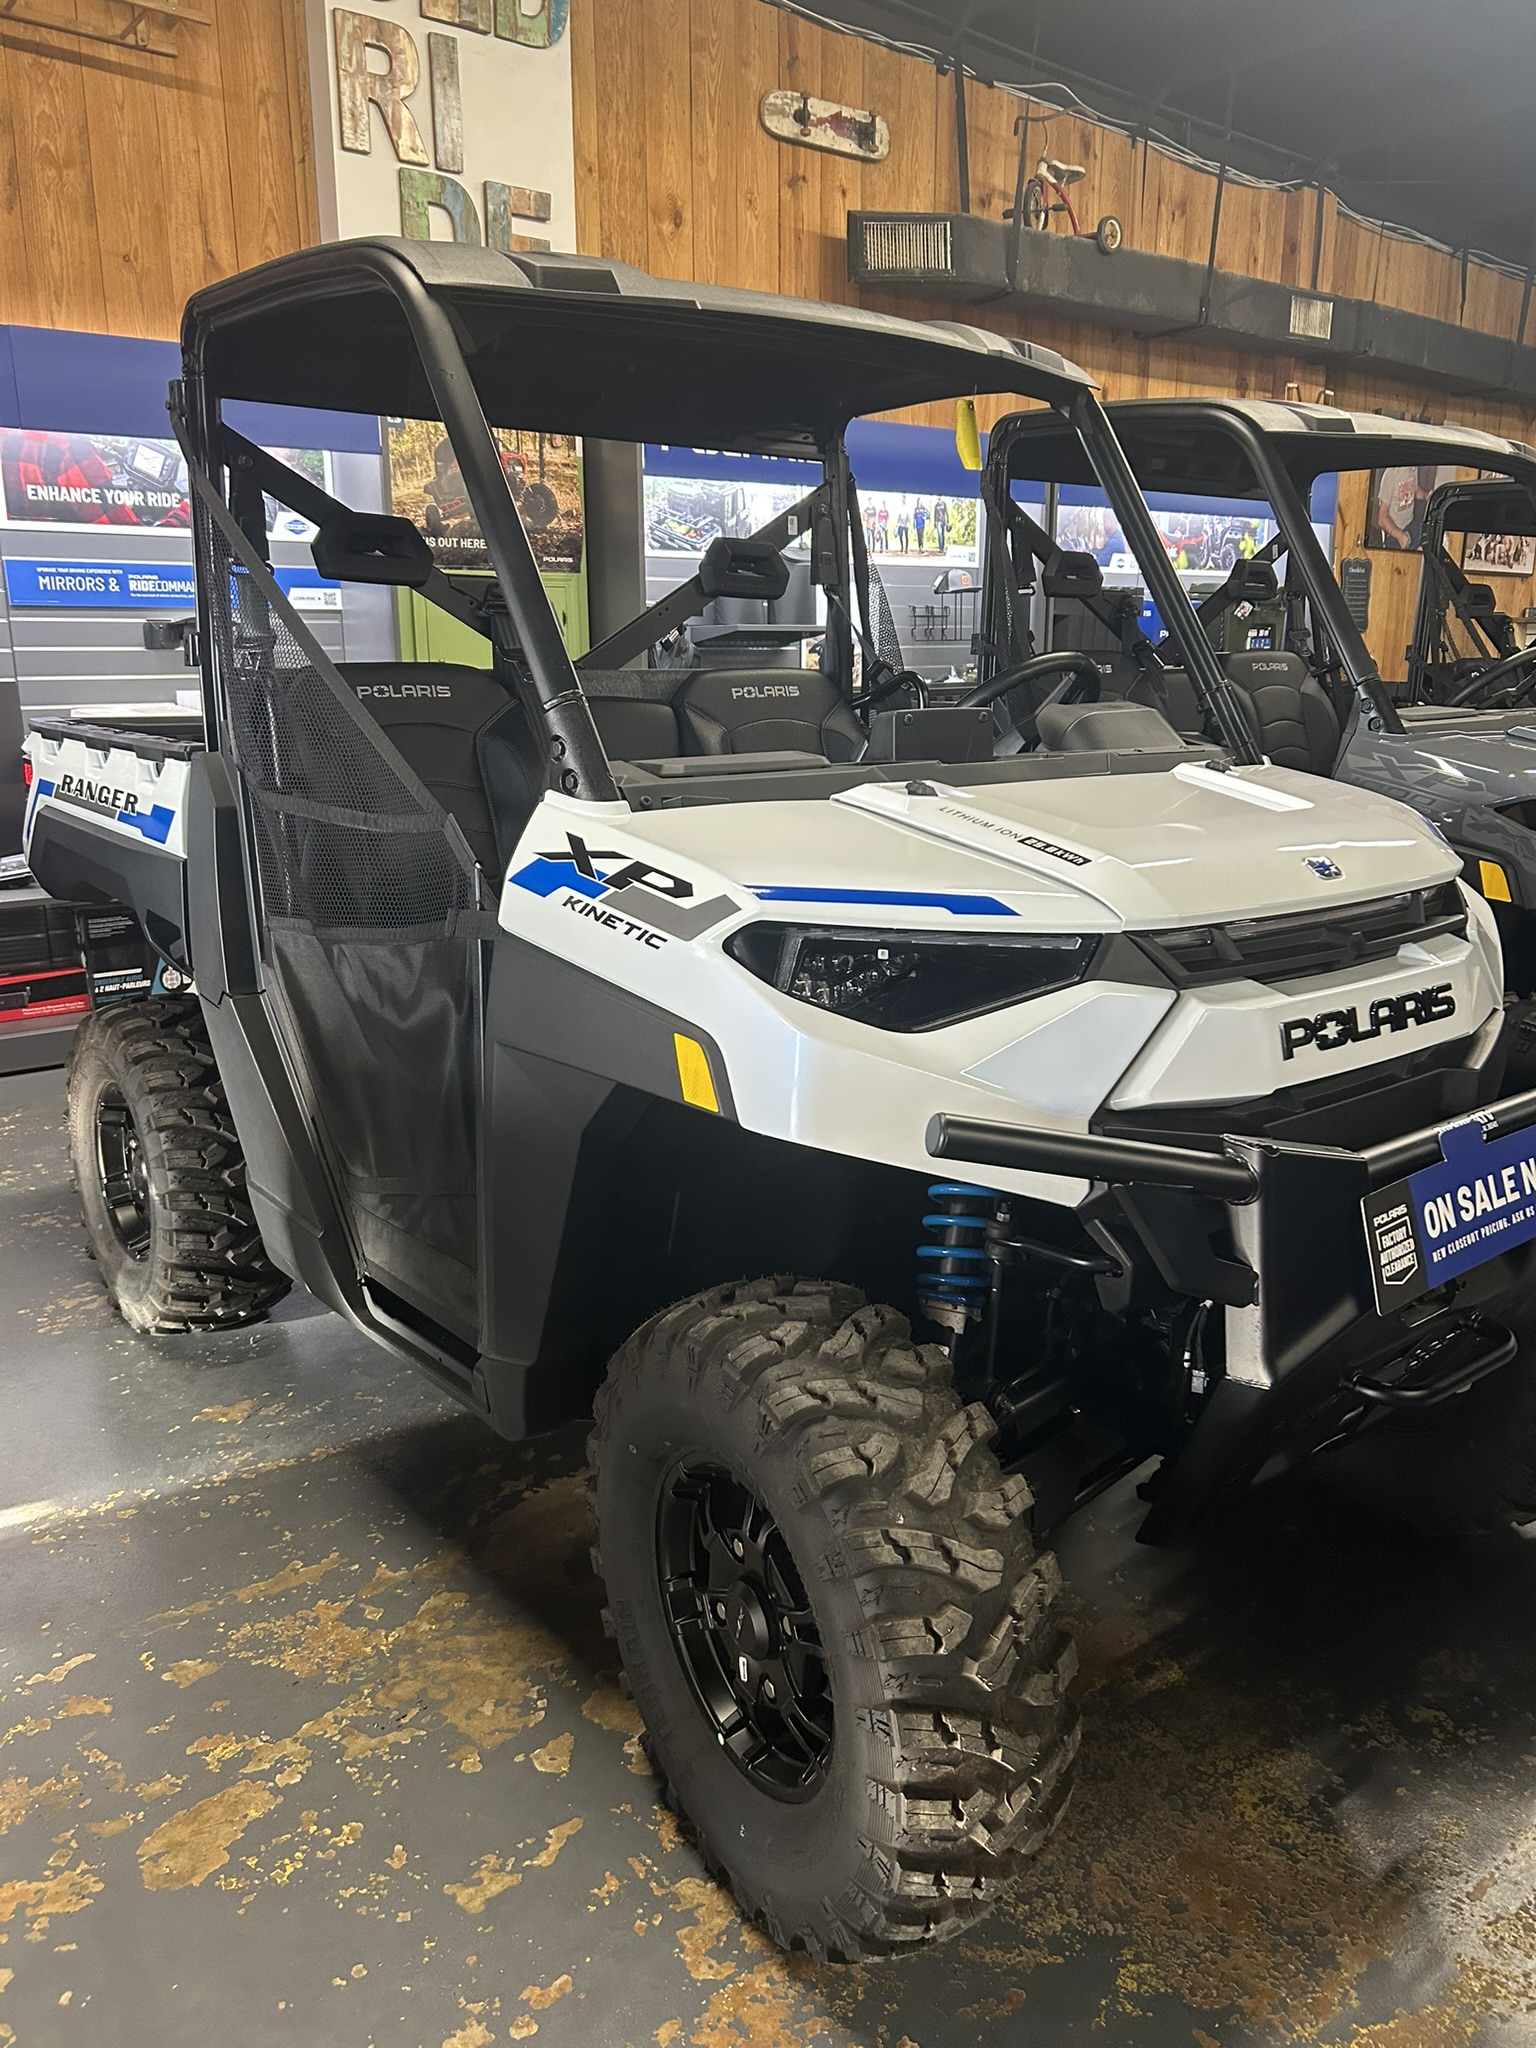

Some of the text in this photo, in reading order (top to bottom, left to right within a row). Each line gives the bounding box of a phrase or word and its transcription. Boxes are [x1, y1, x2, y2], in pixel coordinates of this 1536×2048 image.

[27, 484, 181, 508] ENHANCE YOUR RIDE
[438, 537, 458, 548] OUT
[460, 538, 487, 549] HERE
[38, 576, 120, 592] MIRRORS &
[1252, 662, 1288, 671] POLARIS
[356, 685, 452, 699] POLARIS
[731, 685, 800, 699] POLARIS
[60, 774, 139, 814] RANGER
[939, 806, 994, 829] LITHIUM
[995, 826, 1023, 840] ION
[533, 831, 694, 899] XP
[562, 895, 668, 950] KINETIC
[1279, 982, 1456, 1061] POLARIS
[1423, 1192, 1456, 1239] ON
[1457, 1165, 1521, 1222] SALE
[1373, 1204, 1408, 1227] POLARIS
[1381, 1226, 1407, 1249] FACTORY
[1432, 1205, 1535, 1263] NEW CLOSEOUT PRICING. ASK US
[1380, 1238, 1415, 1266] AUTHORIZED
[1384, 1253, 1415, 1277] CLEARANCE
